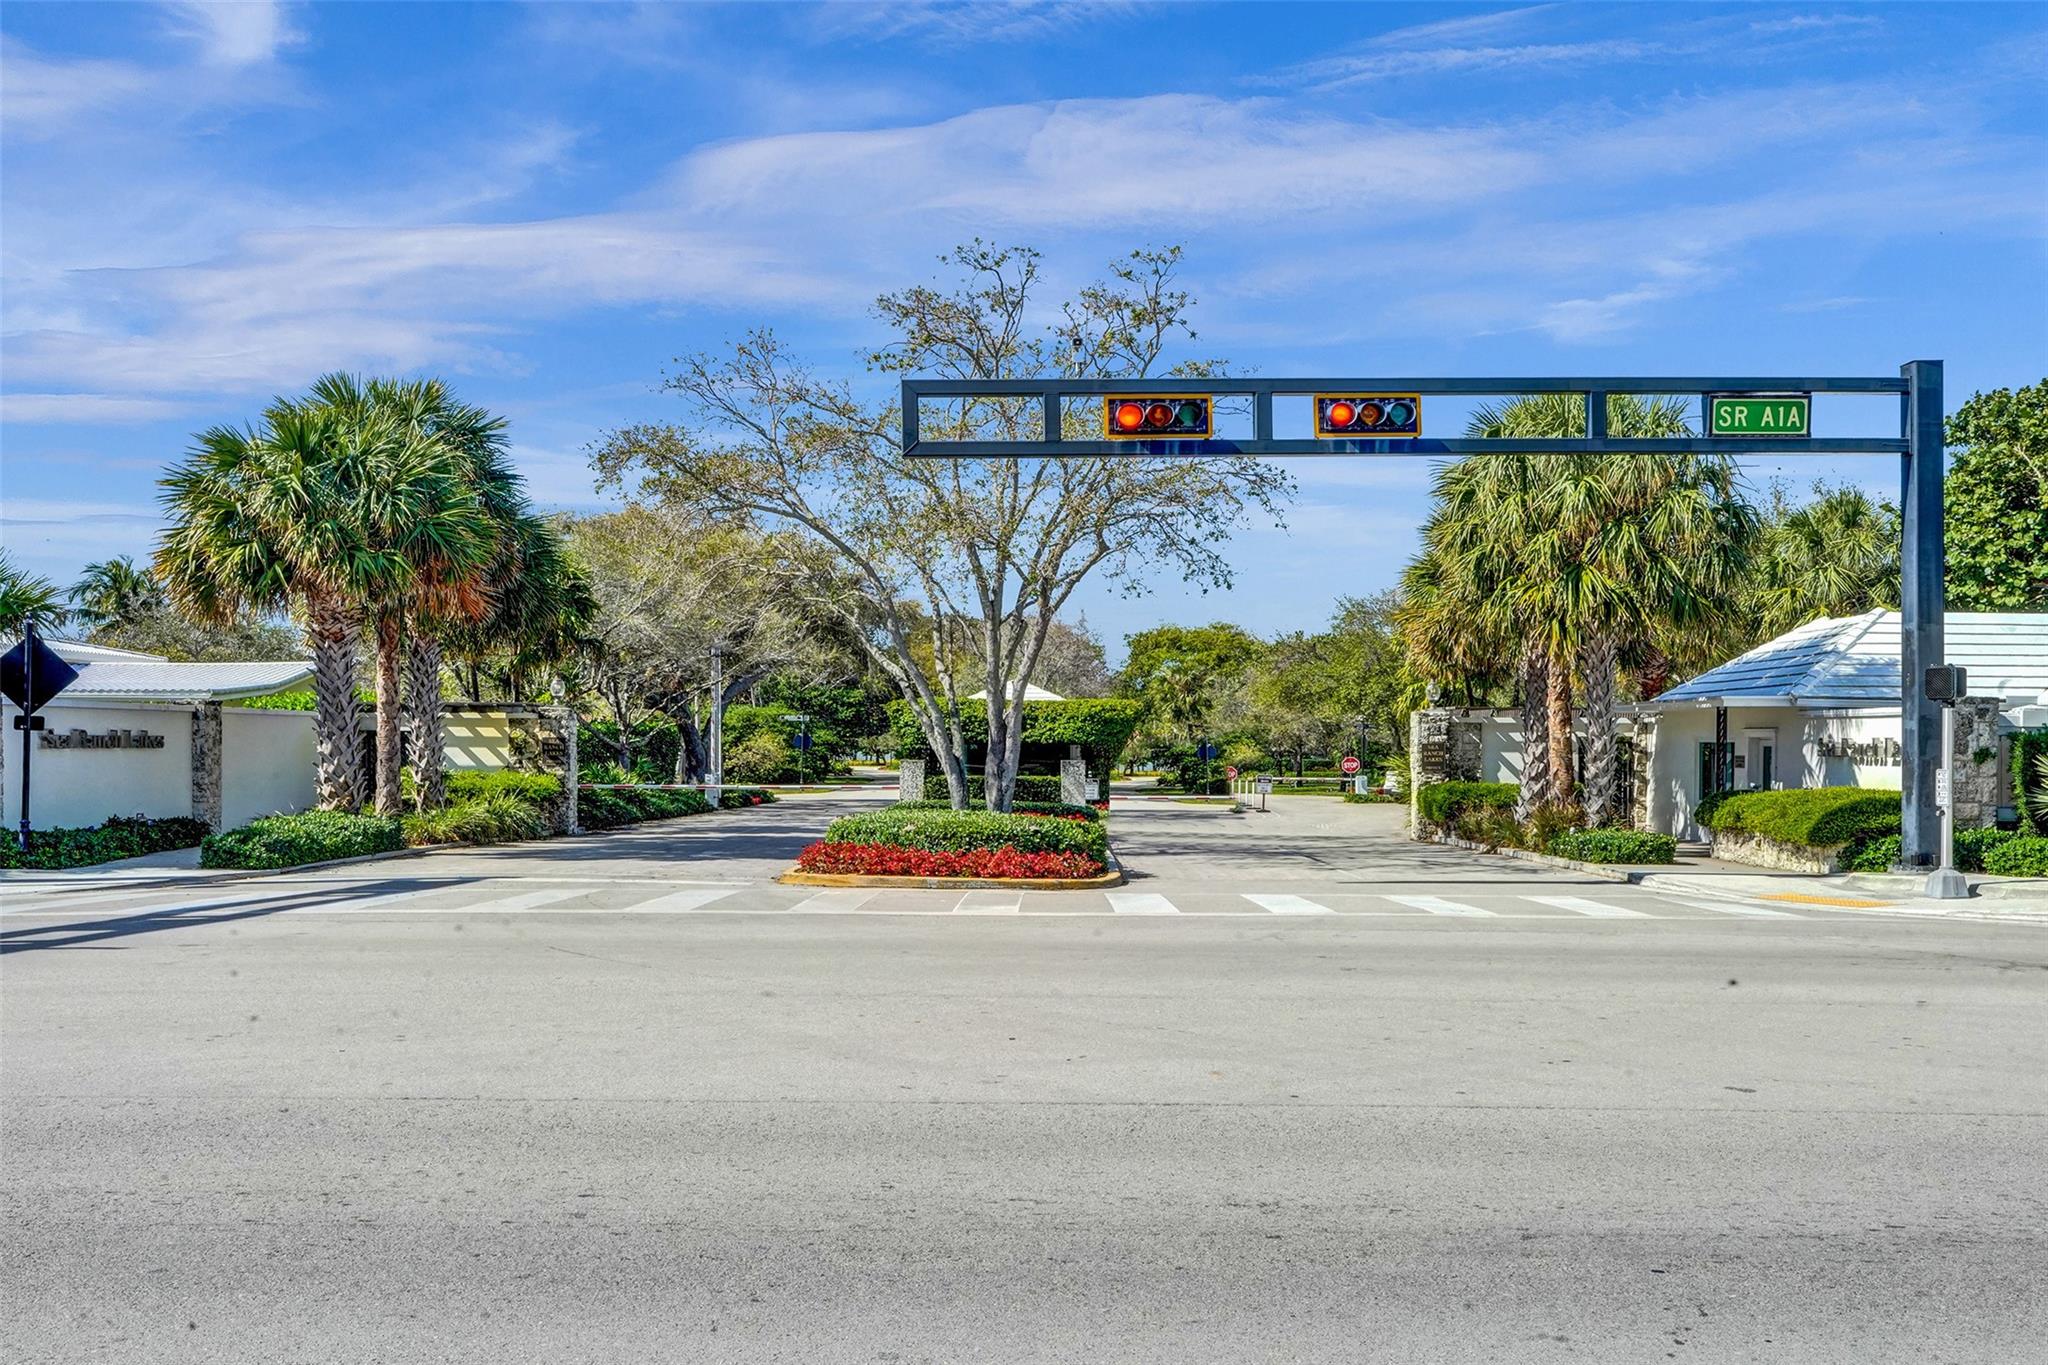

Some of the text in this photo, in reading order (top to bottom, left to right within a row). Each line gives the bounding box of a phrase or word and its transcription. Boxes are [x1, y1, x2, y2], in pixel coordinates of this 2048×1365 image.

[1719, 406, 1800, 427] SR A1A
[1343, 761, 1358, 769] STOP
